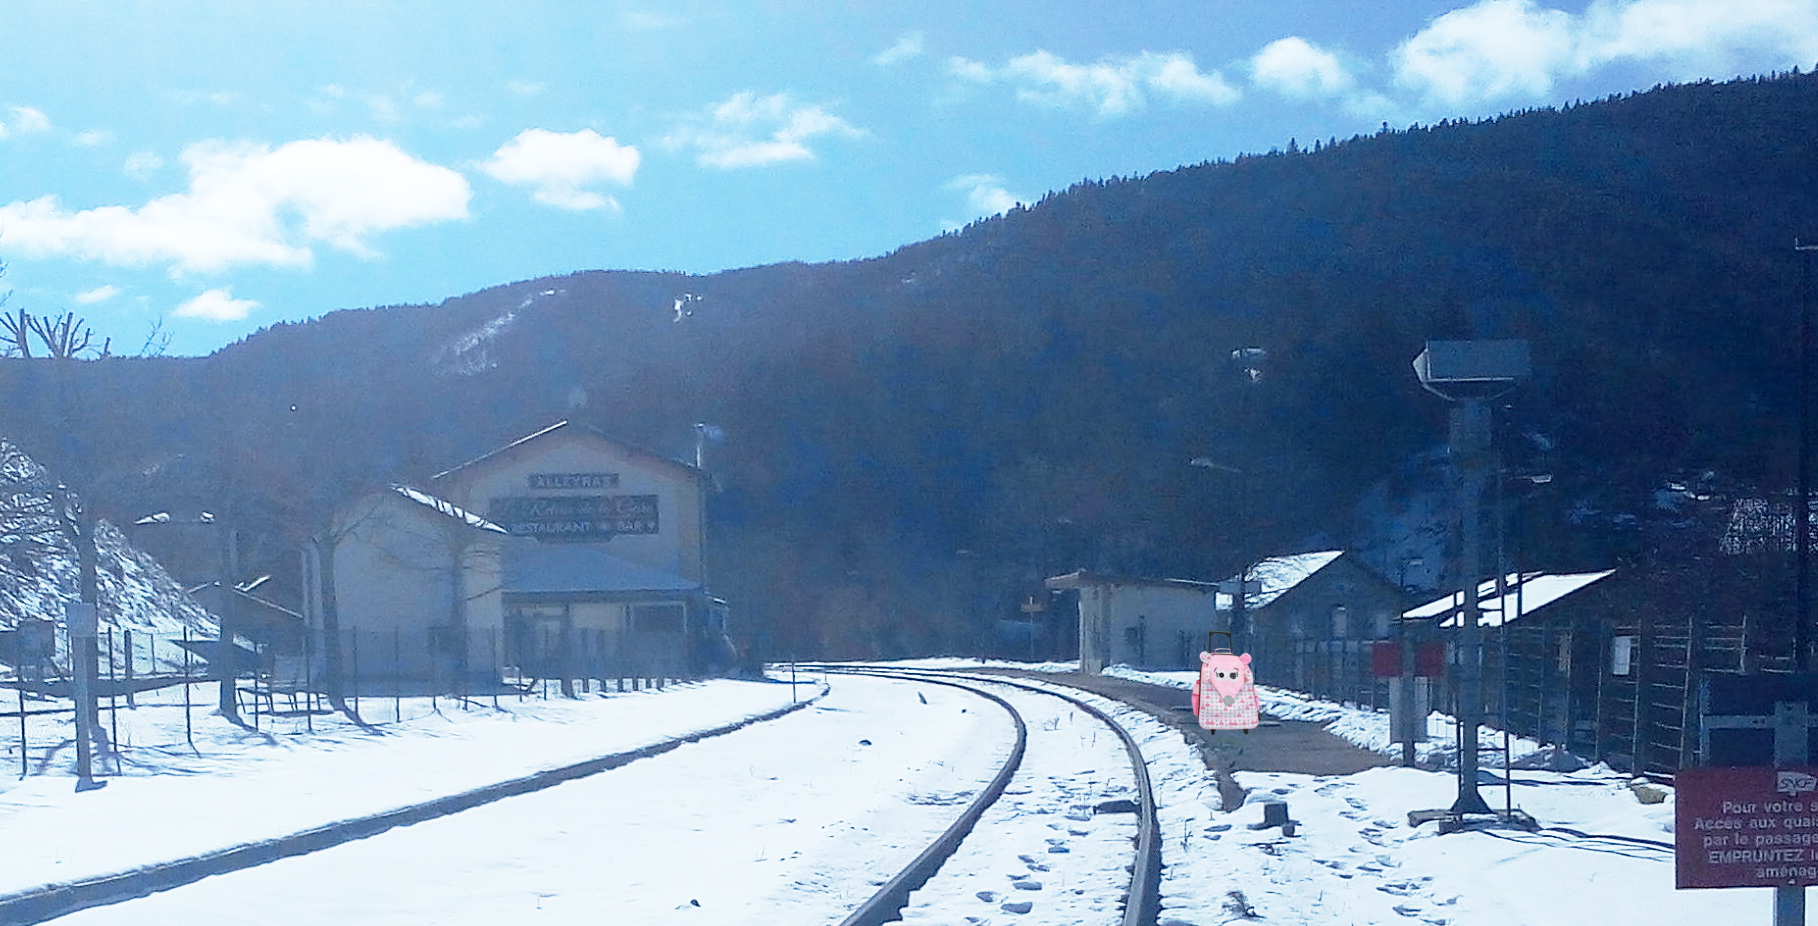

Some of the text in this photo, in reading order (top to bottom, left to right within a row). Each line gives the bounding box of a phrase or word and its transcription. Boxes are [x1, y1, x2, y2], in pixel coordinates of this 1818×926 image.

[537, 475, 611, 488] ALLEYRAS
[617, 520, 644, 532] BAR
[1722, 801, 1757, 814] Pour
[1763, 800, 1803, 813] votre
[1693, 817, 1742, 830] Accès
[1749, 818, 1777, 829] aux
[1703, 835, 1730, 849] par
[1734, 832, 1749, 845] le
[1708, 848, 1805, 864] EMPRUNTEZ
[1755, 865, 1818, 880] aménag
